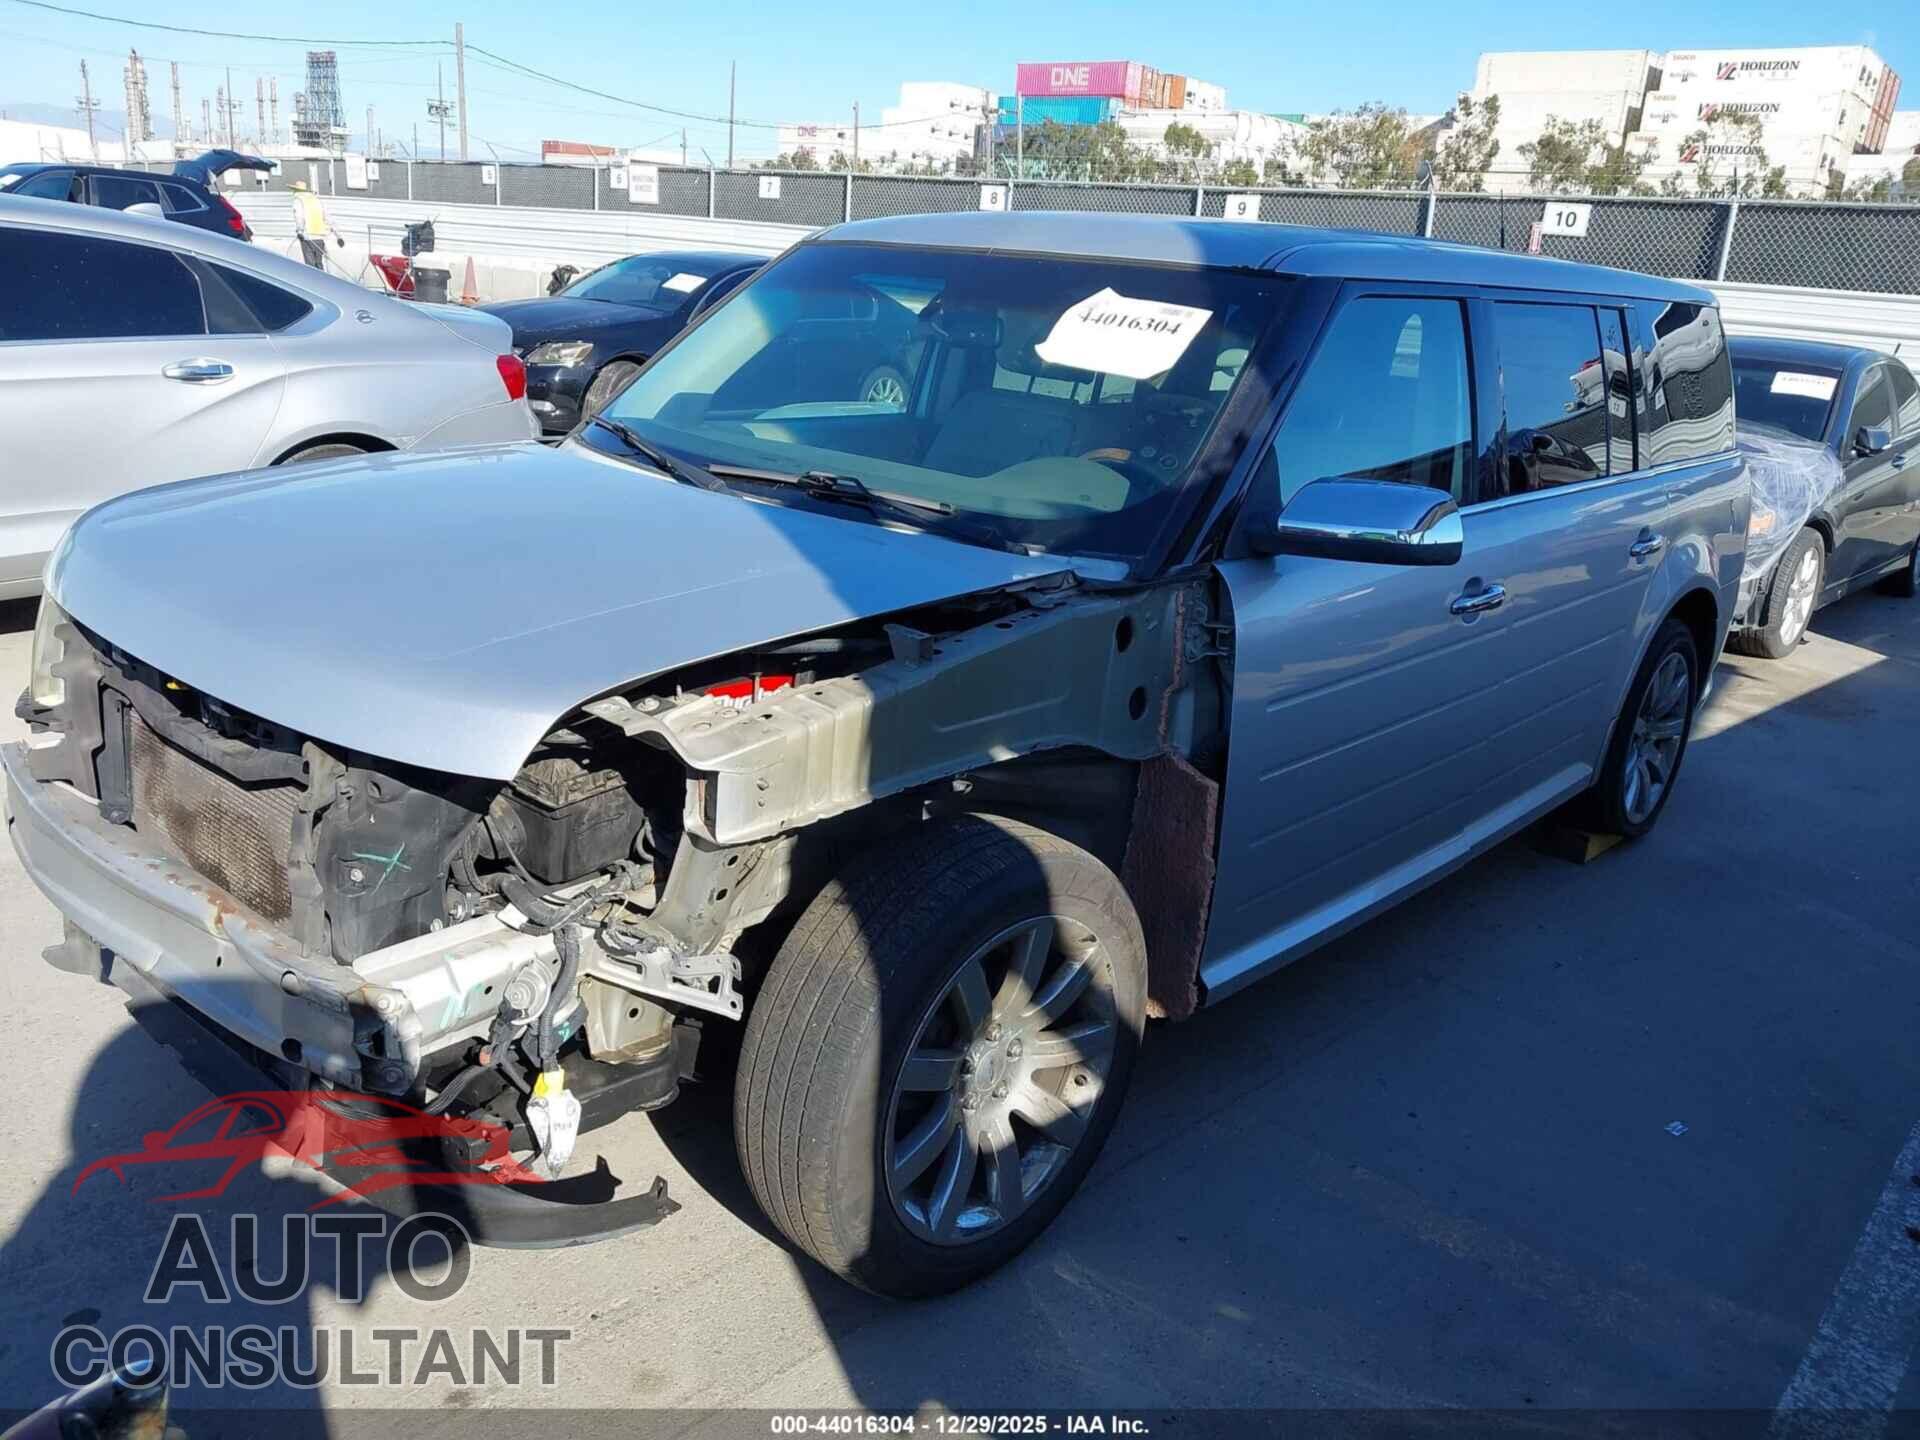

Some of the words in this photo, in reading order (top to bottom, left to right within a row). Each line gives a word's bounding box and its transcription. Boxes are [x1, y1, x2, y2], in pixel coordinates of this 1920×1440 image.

[1740, 60, 1800, 71] HORIZON
[1051, 66, 1089, 86] ONE
[1720, 103, 1780, 113] HORIZON
[1702, 145, 1760, 155] HORIZON
[767, 181, 773, 193] 7
[990, 191, 998, 205] 8
[1237, 201, 1246, 216] 9
[1556, 211, 1577, 228] 10
[1080, 307, 1184, 335] 44016304
